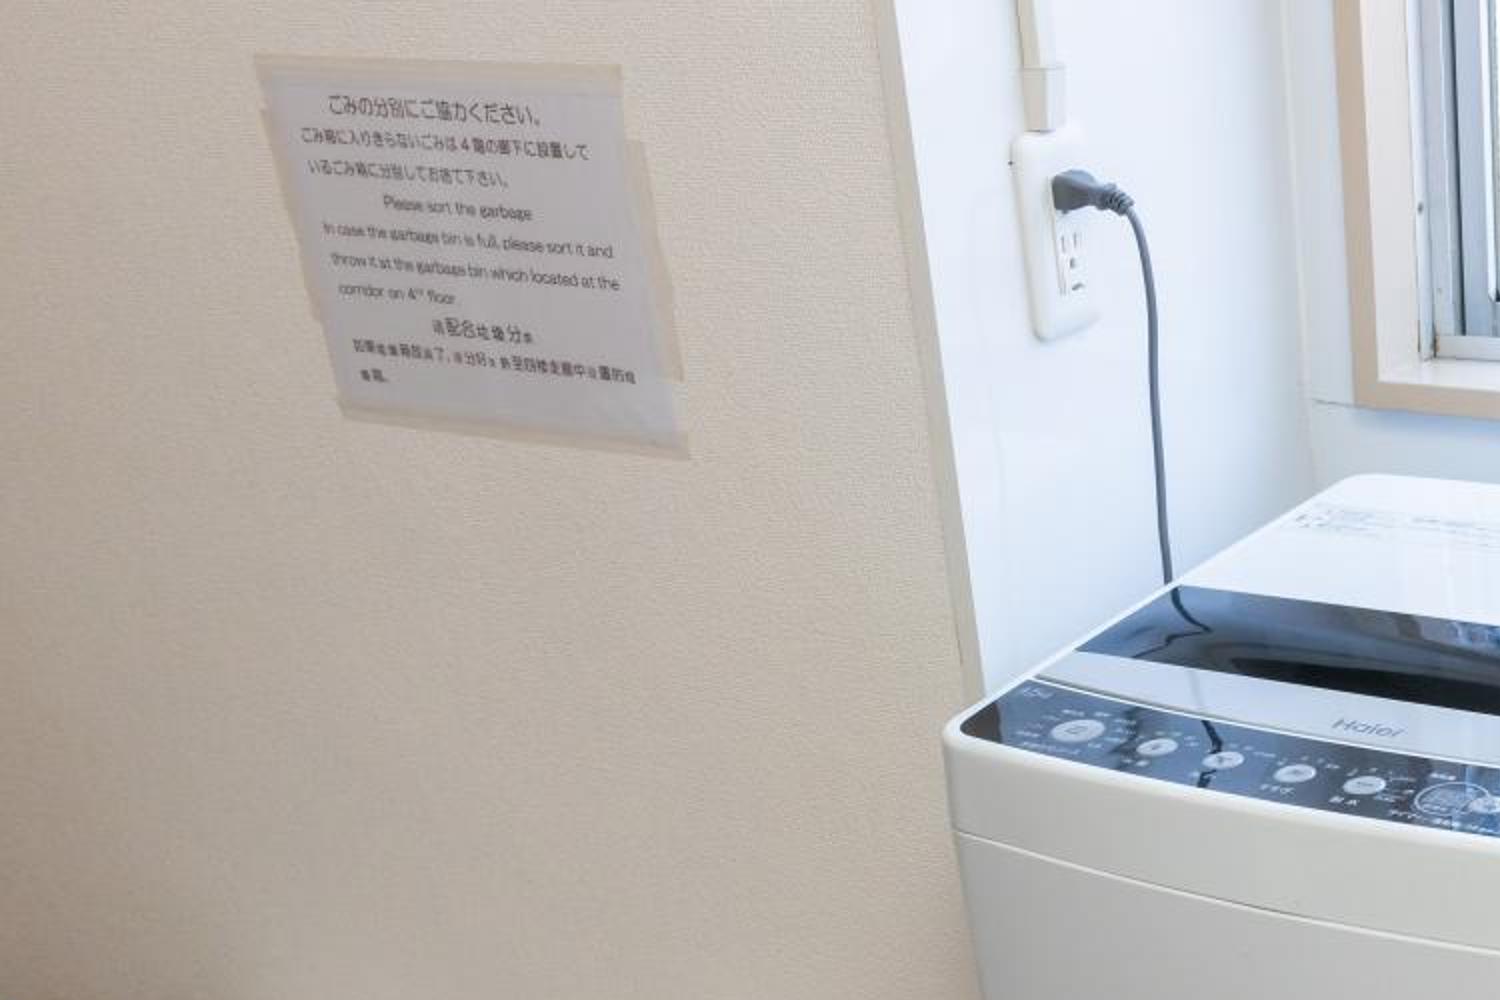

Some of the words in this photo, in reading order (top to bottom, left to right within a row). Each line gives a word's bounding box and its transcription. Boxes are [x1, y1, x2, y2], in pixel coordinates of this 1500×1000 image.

[328, 95, 541, 127] ごみの分別にご協力ください。
[383, 194, 422, 213] Please
[427, 199, 449, 214] sort
[454, 200, 476, 216] the
[479, 203, 533, 222] garbage
[367, 225, 386, 239] the
[389, 227, 439, 245] garbage
[502, 235, 543, 254] please
[547, 240, 570, 255] sort
[587, 245, 614, 260] and
[393, 255, 413, 272] the
[415, 259, 465, 277] garbage
[489, 264, 529, 284] which
[531, 267, 578, 287] located
[581, 275, 594, 288] at
[597, 274, 621, 292] the
[1331, 718, 1407, 738] Haier
